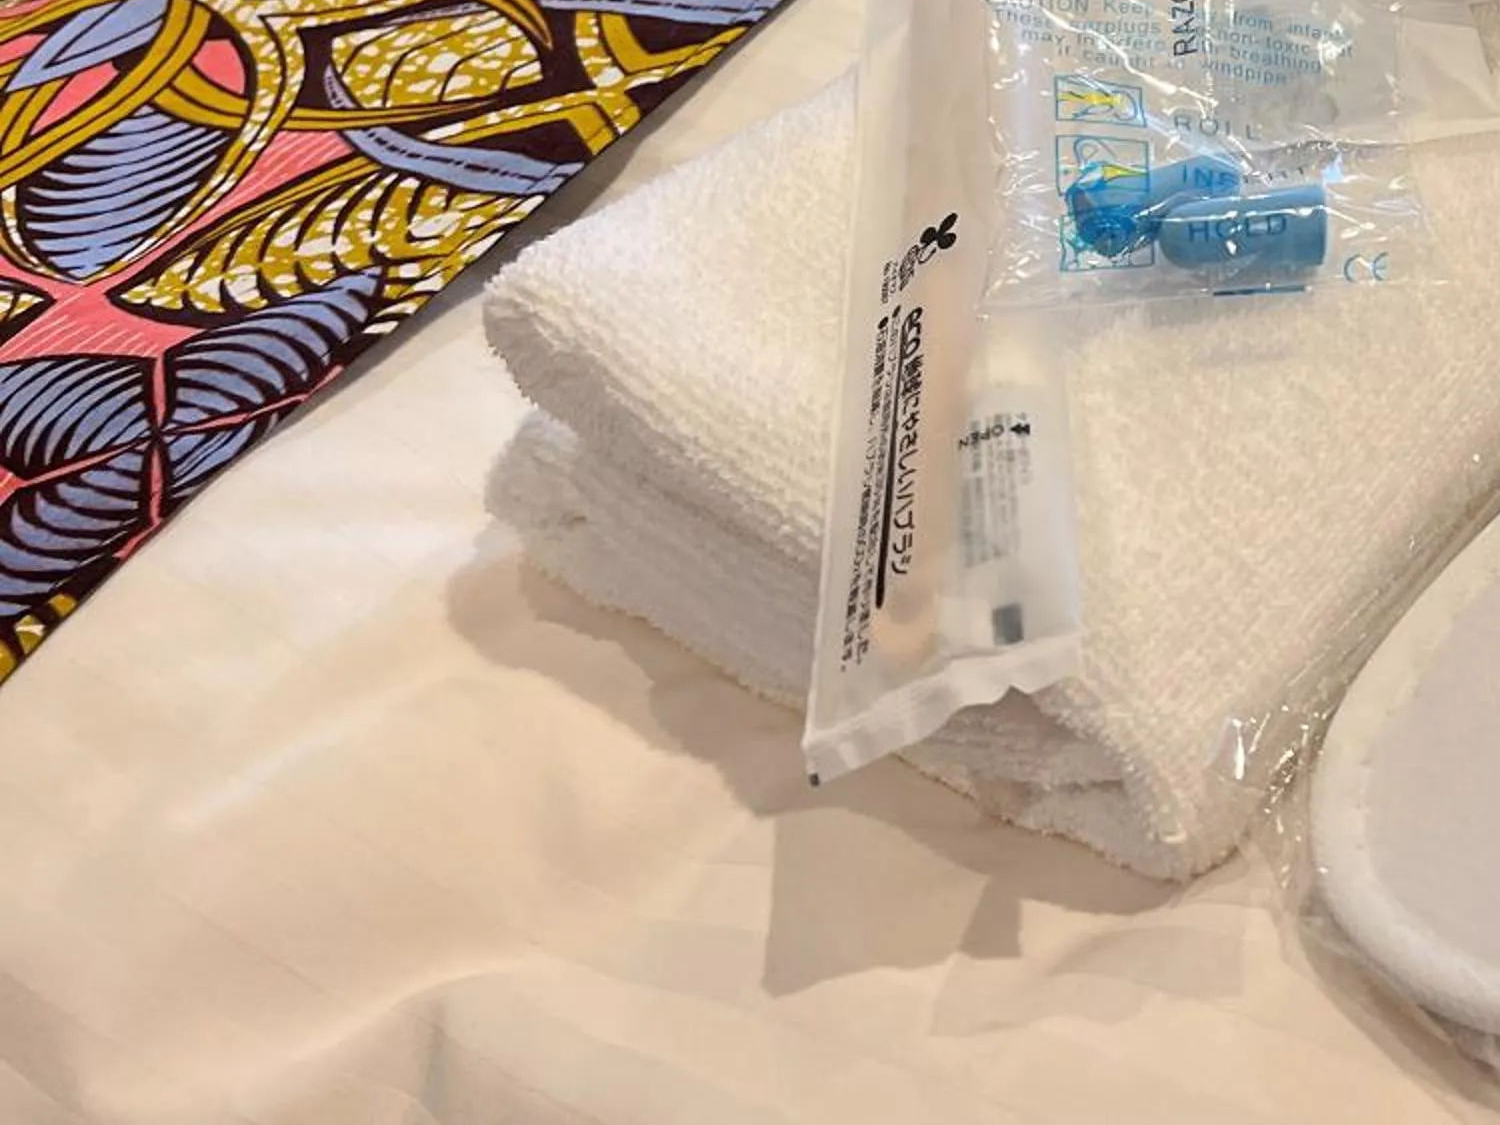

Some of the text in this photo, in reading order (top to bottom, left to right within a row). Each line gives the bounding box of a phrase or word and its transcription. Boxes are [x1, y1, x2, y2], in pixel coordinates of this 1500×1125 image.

[1022, 30, 1067, 46] may
[1188, 214, 1287, 242] HOLD
[957, 423, 1005, 451] OPEN
